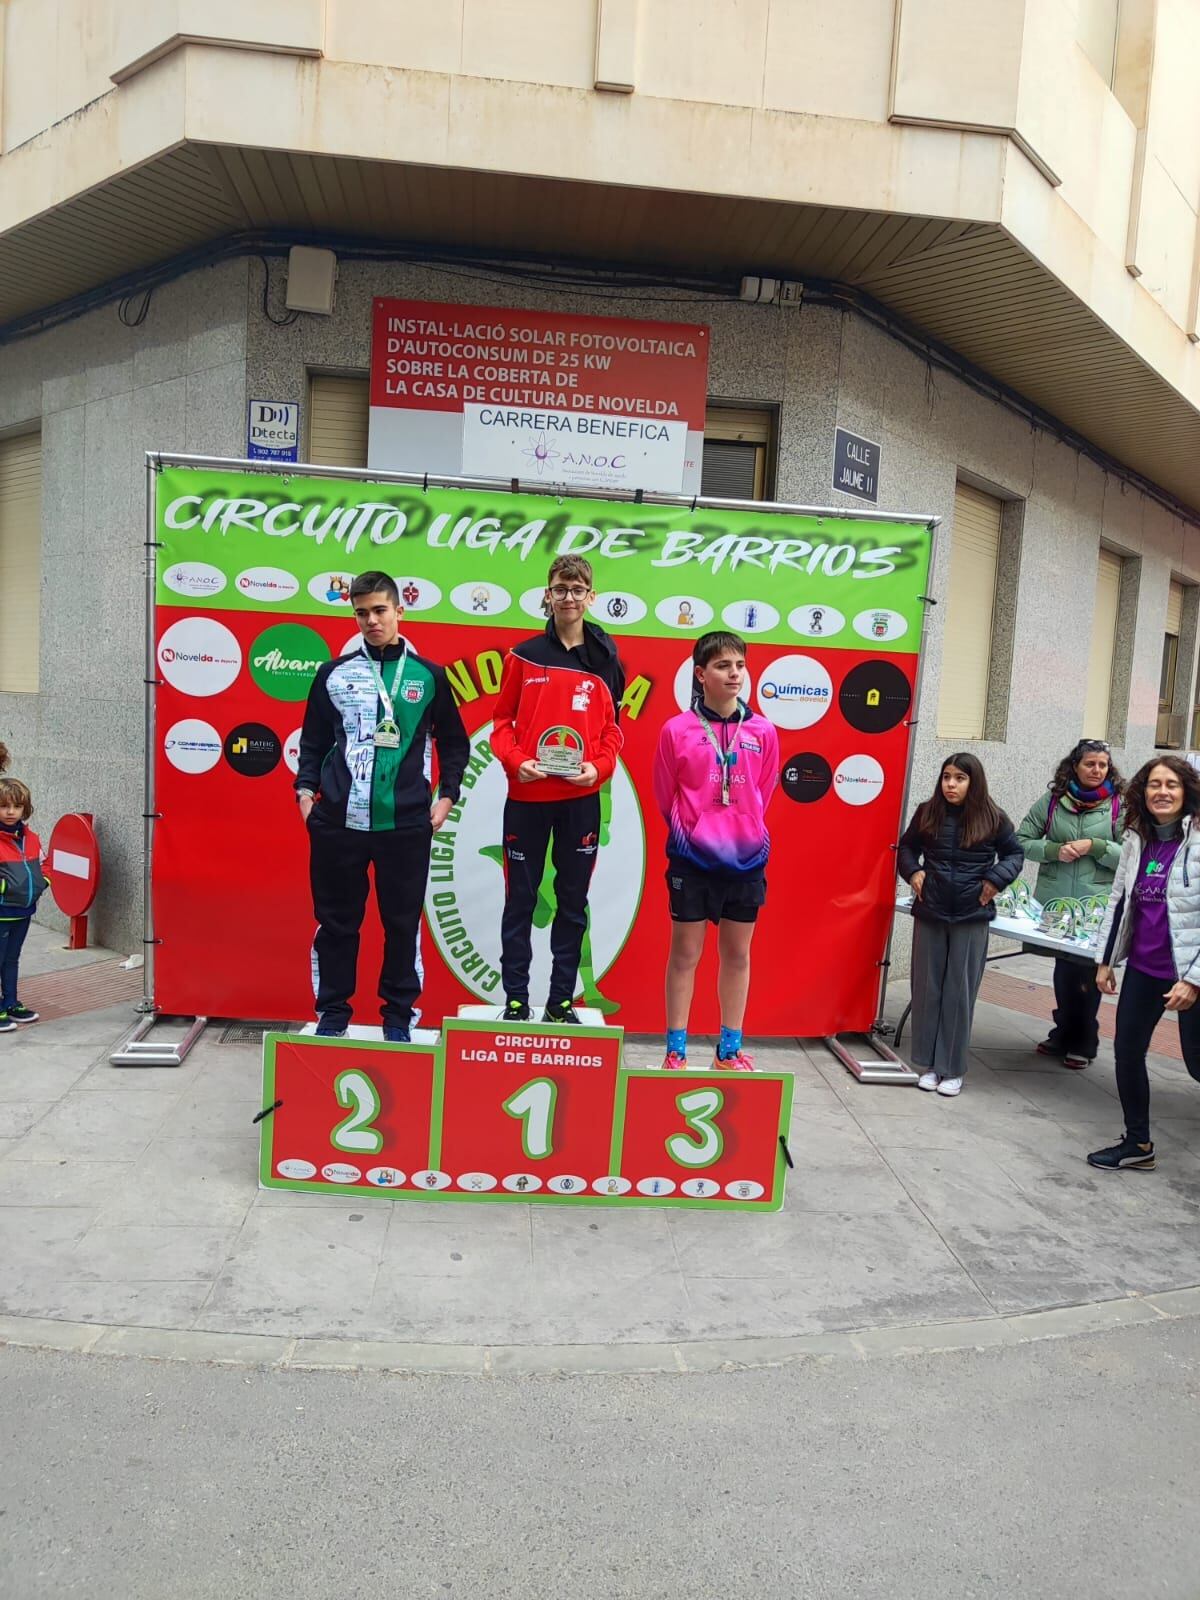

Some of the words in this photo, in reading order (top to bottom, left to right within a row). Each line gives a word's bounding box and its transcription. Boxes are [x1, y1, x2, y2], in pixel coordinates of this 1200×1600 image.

[387, 338, 528, 364] D'AUTOCONSUM
[532, 350, 555, 366] DE
[559, 351, 580, 367] 25
[584, 354, 612, 370] KW
[388, 317, 505, 341] INSTAL·LACIÓ
[509, 327, 566, 346] SOLAR
[570, 333, 697, 358] FOTOVOLTAICA
[386, 359, 444, 377] SOBRE
[447, 363, 470, 379] LA
[473, 365, 552, 385] COBERTA
[555, 372, 579, 388] DE
[385, 379, 408, 395] LA
[412, 381, 459, 399] CASA
[463, 384, 486, 400] DE
[489, 386, 568, 408] CULTURA
[571, 392, 595, 409] DE
[598, 395, 679, 416] NOVELDA
[252, 426, 296, 441] Dtecta
[479, 408, 572, 434] CARRERA
[577, 418, 670, 442] BENEFICA
[846, 441, 871, 467] CALLE
[163, 494, 407, 554] CIRCUITO
[426, 512, 548, 562] LIGA
[554, 524, 646, 559] DE
[650, 531, 903, 579] BARRIOS
[250, 578, 277, 589] Novelda
[175, 651, 213, 663] Novelda
[761, 681, 829, 700] Químicas
[430, 831, 457, 883] LIGA
[432, 891, 501, 993] CIRCUITO
[461, 1049, 498, 1063] LIGA
[503, 1051, 526, 1064] DE
[531, 1053, 603, 1068] BARRIOS
[494, 1034, 572, 1050] CIRCUITO
[332, 1070, 381, 1152] 2
[504, 1079, 555, 1158] 1
[667, 1088, 721, 1166] 3
